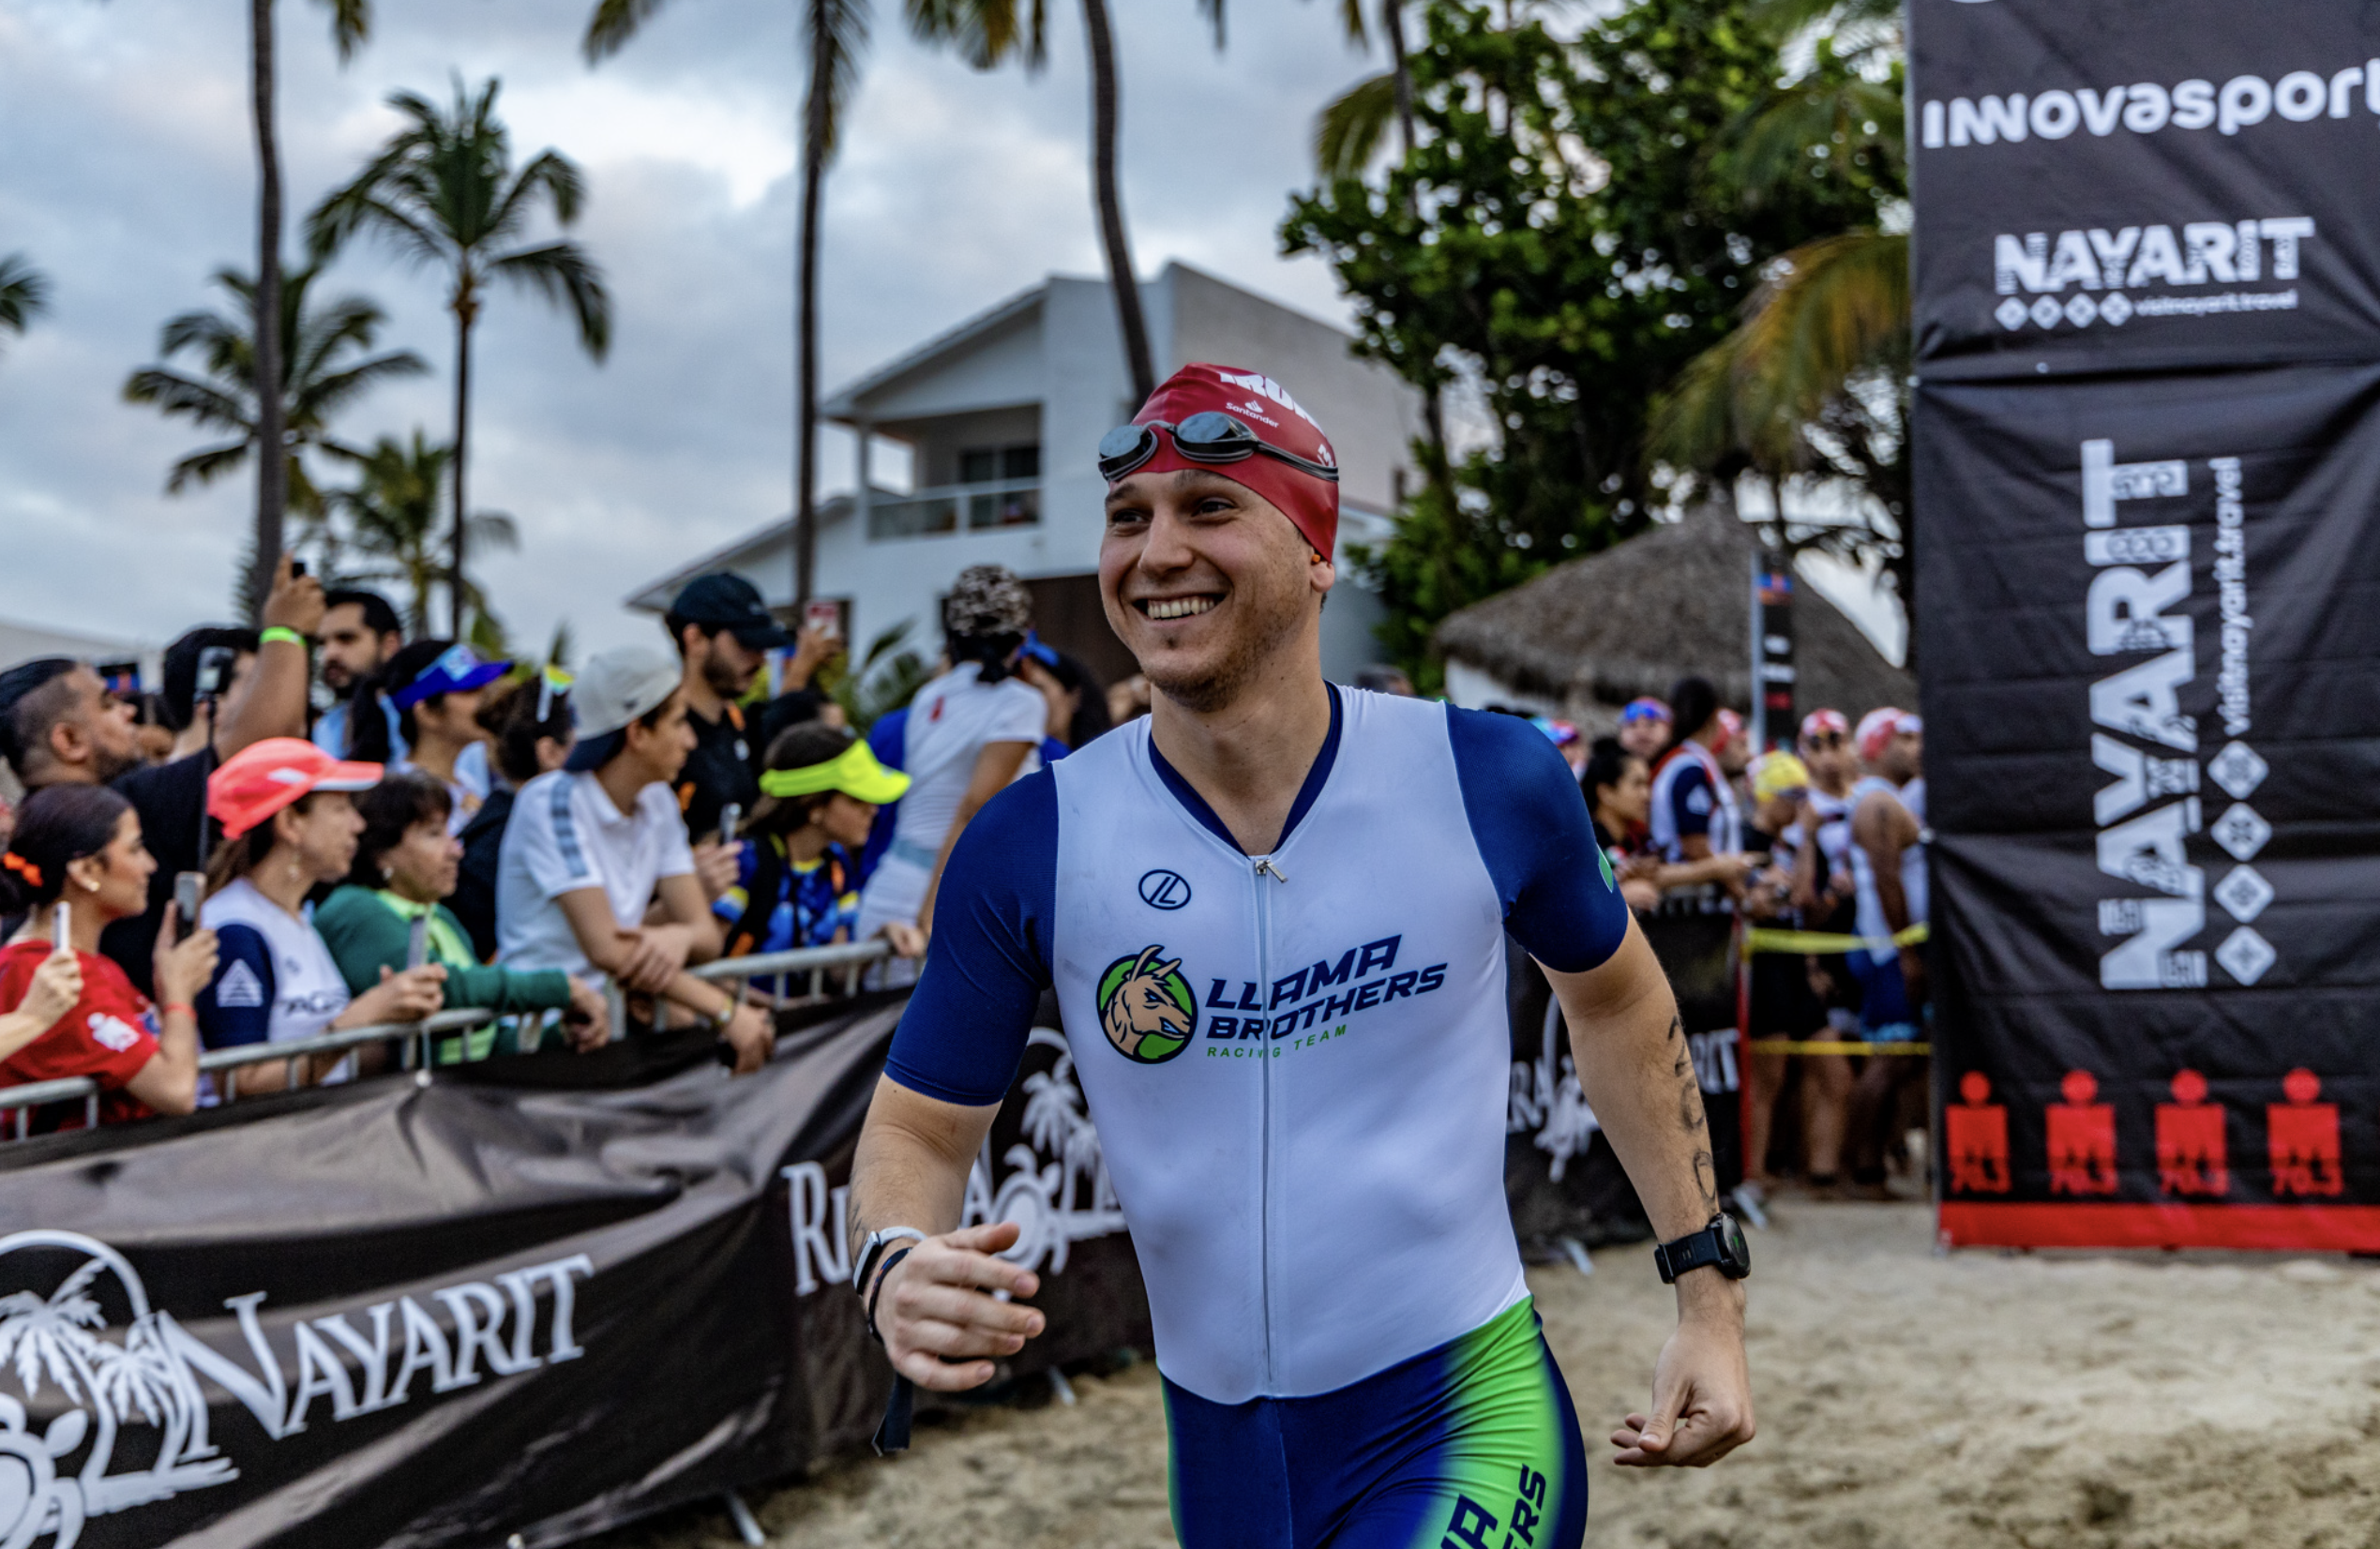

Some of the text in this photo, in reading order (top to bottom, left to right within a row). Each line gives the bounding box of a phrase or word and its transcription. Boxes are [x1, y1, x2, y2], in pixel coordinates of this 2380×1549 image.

[1994, 216, 2314, 295] NAYARIT
[1225, 402, 1279, 428] Santander
[2081, 438, 2208, 990] NAYARIT
[1205, 934, 1402, 1012] LLAMA
[1206, 962, 1449, 1042] BROTHERS
[1293, 1024, 1348, 1051] TEAM
[157, 1253, 595, 1462] NAYARIT
